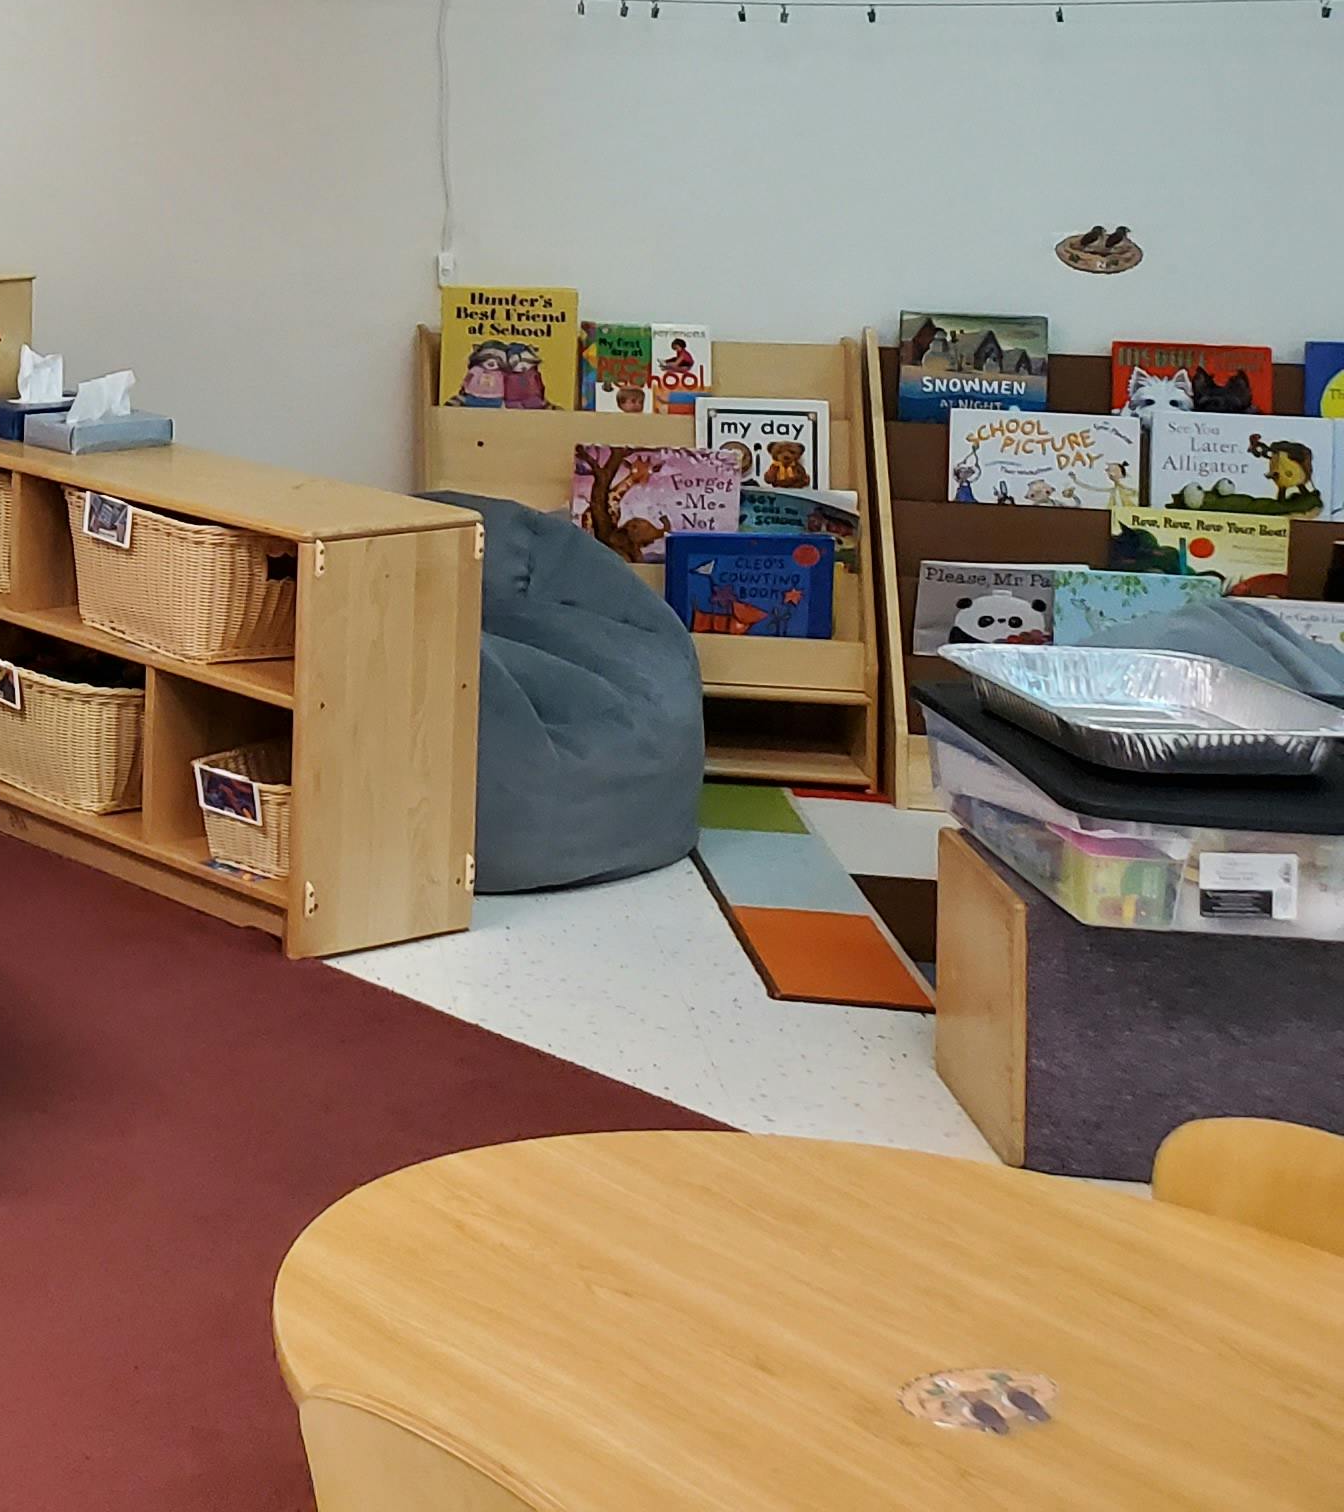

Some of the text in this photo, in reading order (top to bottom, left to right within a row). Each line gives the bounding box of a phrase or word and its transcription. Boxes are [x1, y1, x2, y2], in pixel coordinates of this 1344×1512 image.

[470, 292, 553, 308] Hunter's
[456, 307, 566, 323] Best Friend
[468, 323, 552, 337] at School
[922, 376, 1026, 395] SNOWMEN
[958, 399, 1002, 410] NIGHT
[720, 419, 804, 440] my day
[966, 419, 1049, 446] SCHOOL
[1168, 421, 1220, 435] See You
[1000, 429, 1096, 456] PICTURE
[1057, 451, 1104, 470] DAY
[1162, 455, 1249, 477] Alligator
[670, 473, 733, 494] Forget
[681, 513, 716, 530] Not
[1196, 519, 1223, 533] Row
[1226, 521, 1256, 535] Your
[1258, 524, 1287, 538] Boat
[734, 556, 785, 570] CLEO'S
[719, 571, 801, 587] COUNTING
[925, 567, 990, 588] Please,
[1029, 573, 1054, 588] Pa
